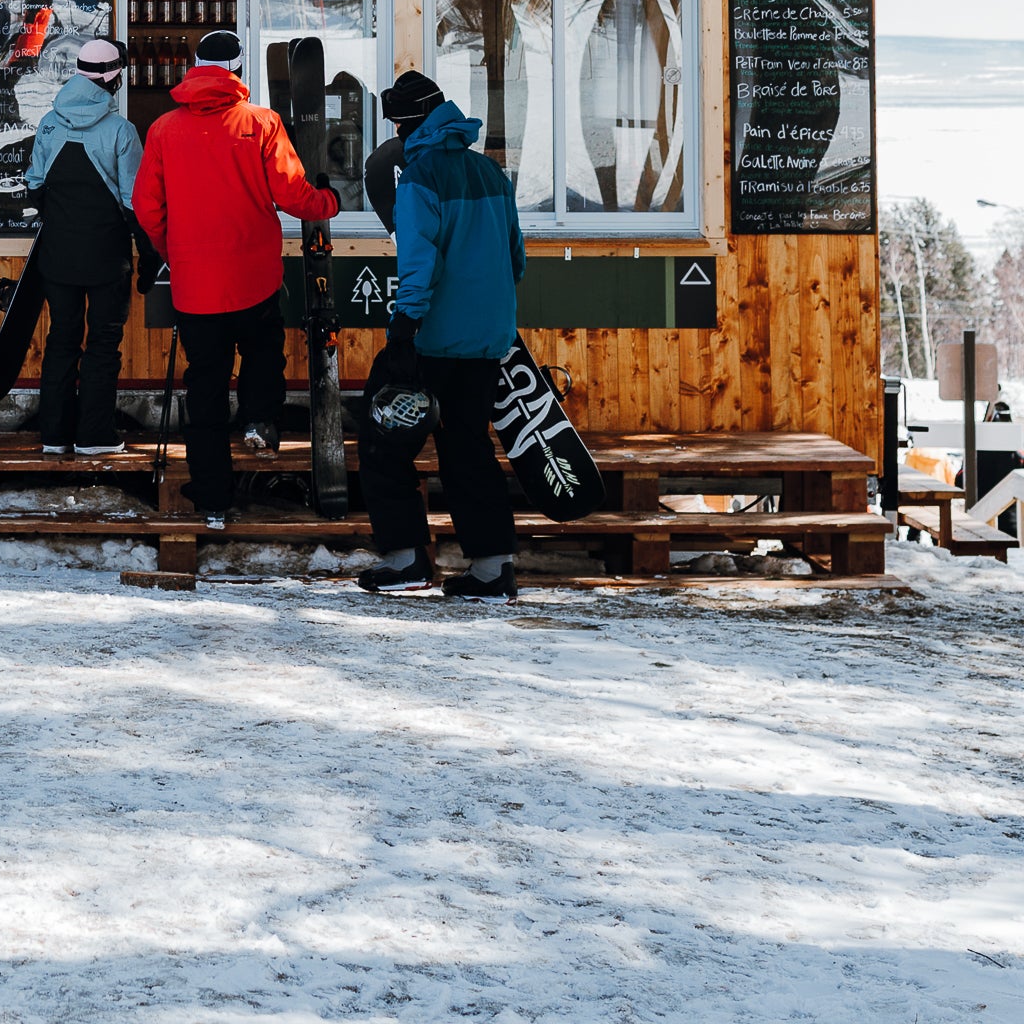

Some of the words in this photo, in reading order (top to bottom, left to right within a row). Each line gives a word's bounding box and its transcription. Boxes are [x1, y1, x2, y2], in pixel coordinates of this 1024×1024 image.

[790, 80, 808, 97] de
[301, 114, 319, 122] LINE
[743, 123, 771, 138] Pain
